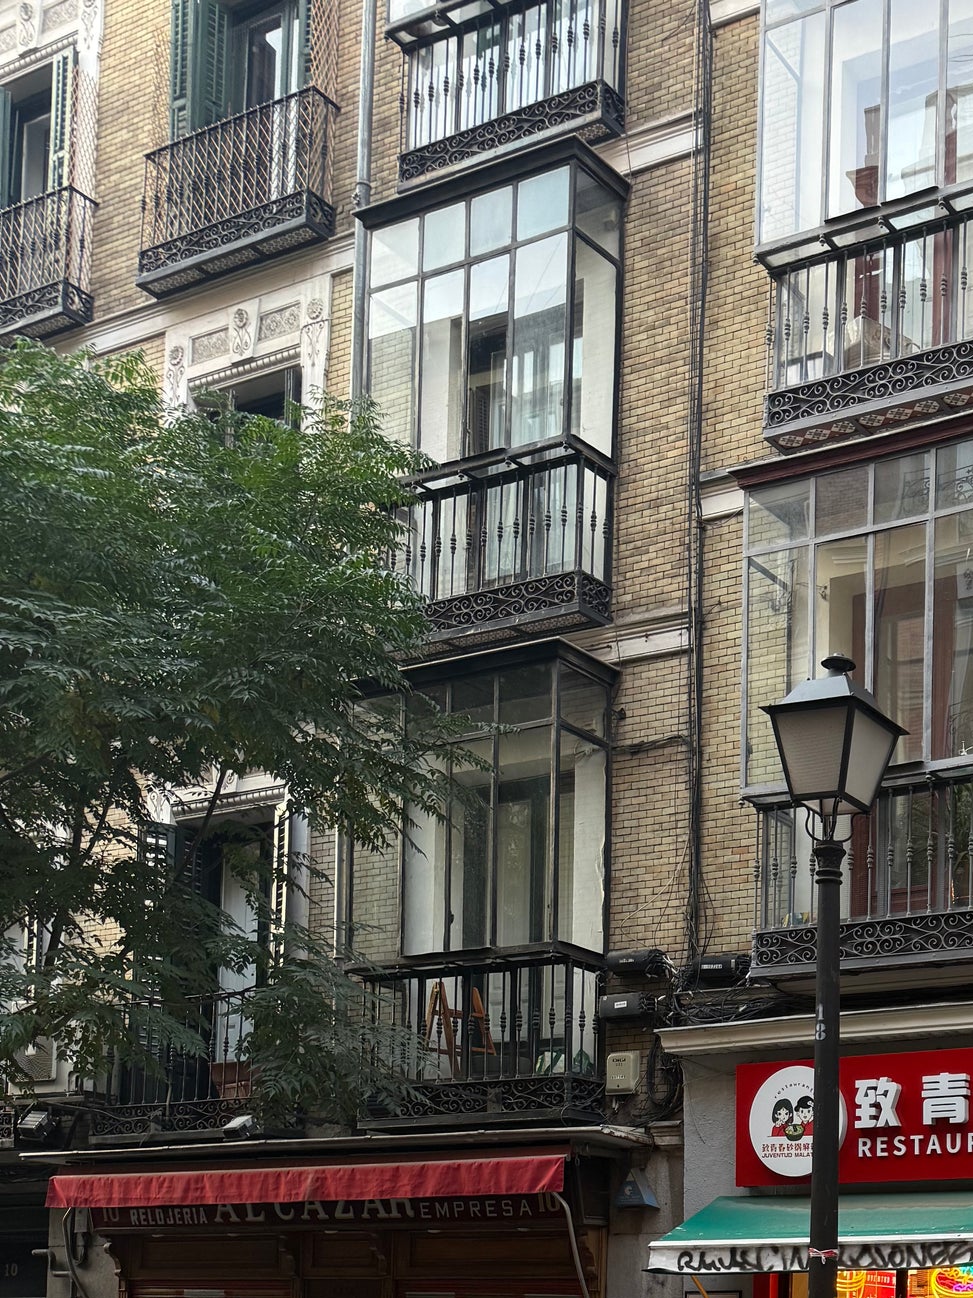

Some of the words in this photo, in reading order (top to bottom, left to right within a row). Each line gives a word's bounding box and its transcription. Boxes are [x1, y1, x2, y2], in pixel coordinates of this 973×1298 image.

[774, 1082, 814, 1099] restaurant
[129, 1207, 209, 1226] RELOJERIA
[214, 1197, 415, 1223] ALCAZAR
[420, 1200, 533, 1219] EMPRESA
[3, 1263, 19, 1277] 10
